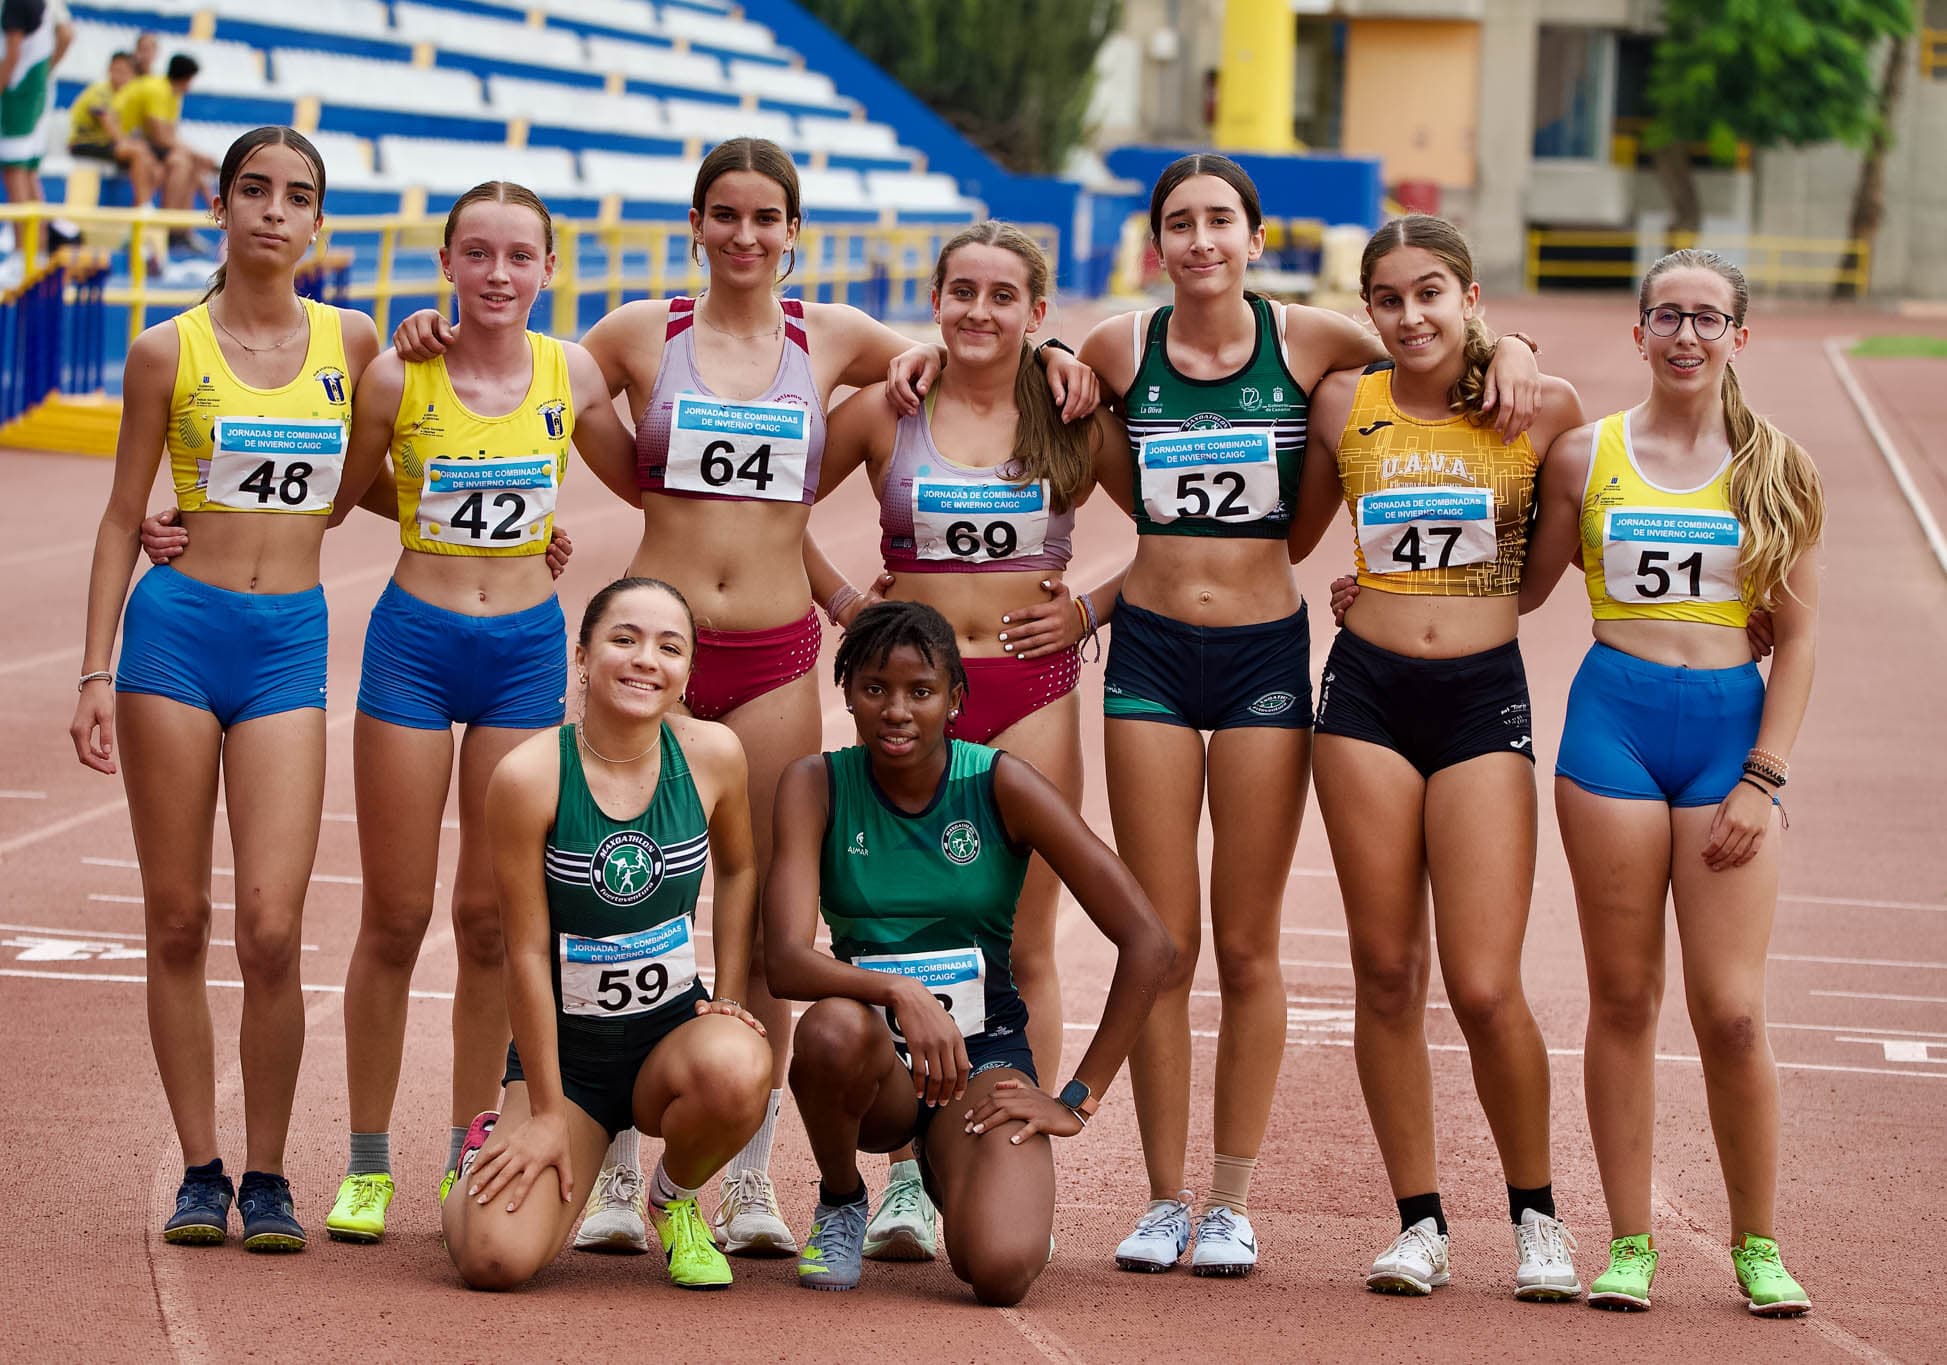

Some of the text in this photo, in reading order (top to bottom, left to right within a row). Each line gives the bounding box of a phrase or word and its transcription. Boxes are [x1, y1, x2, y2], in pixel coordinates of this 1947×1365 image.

[684, 407, 798, 424] JORNADAS DE COMBINADAS
[701, 417, 781, 433] DE INVIERNO CAIGC
[227, 428, 337, 440] JORNADAS DE COMBINADAS
[244, 439, 322, 450] DE INVIERNO CAIGC
[1149, 439, 1263, 455] JORNADAS DE COMBINADAS
[1166, 450, 1246, 463] DE INVIERNO CAIGC
[700, 439, 774, 491] 64
[439, 468, 542, 479] ORNADAS DE COMBINADA
[238, 460, 313, 505] 48
[452, 478, 532, 489] DE INVIERNO CAIGC
[923, 489, 1038, 499] JORNADAS DE COMBINADAS
[1176, 471, 1250, 518] 52
[940, 500, 1021, 509] DE INVIERNO CAIGC
[1368, 498, 1481, 510] JORNADAS DE COMBINADAS
[450, 492, 527, 540] 42
[1385, 508, 1464, 519] DE INVIERNO CAIGC
[1616, 518, 1734, 531] JORNADAS DE COMBINADAS
[945, 520, 1018, 559] 69
[1633, 528, 1716, 540] DE INVIERNO CAIGC
[1392, 526, 1463, 571] 47
[1635, 550, 1703, 598] 51
[600, 834, 656, 859] MAXOATHLON
[600, 882, 654, 903] fuerteventura
[572, 924, 682, 953] JORNADAS DE COMBINADAS
[591, 941, 670, 962] DE INVIERNO CAIGC
[904, 966, 916, 974] DE
[917, 960, 973, 973] COMBINADAS
[929, 972, 956, 981] CAIGC
[597, 962, 669, 1011] 59
